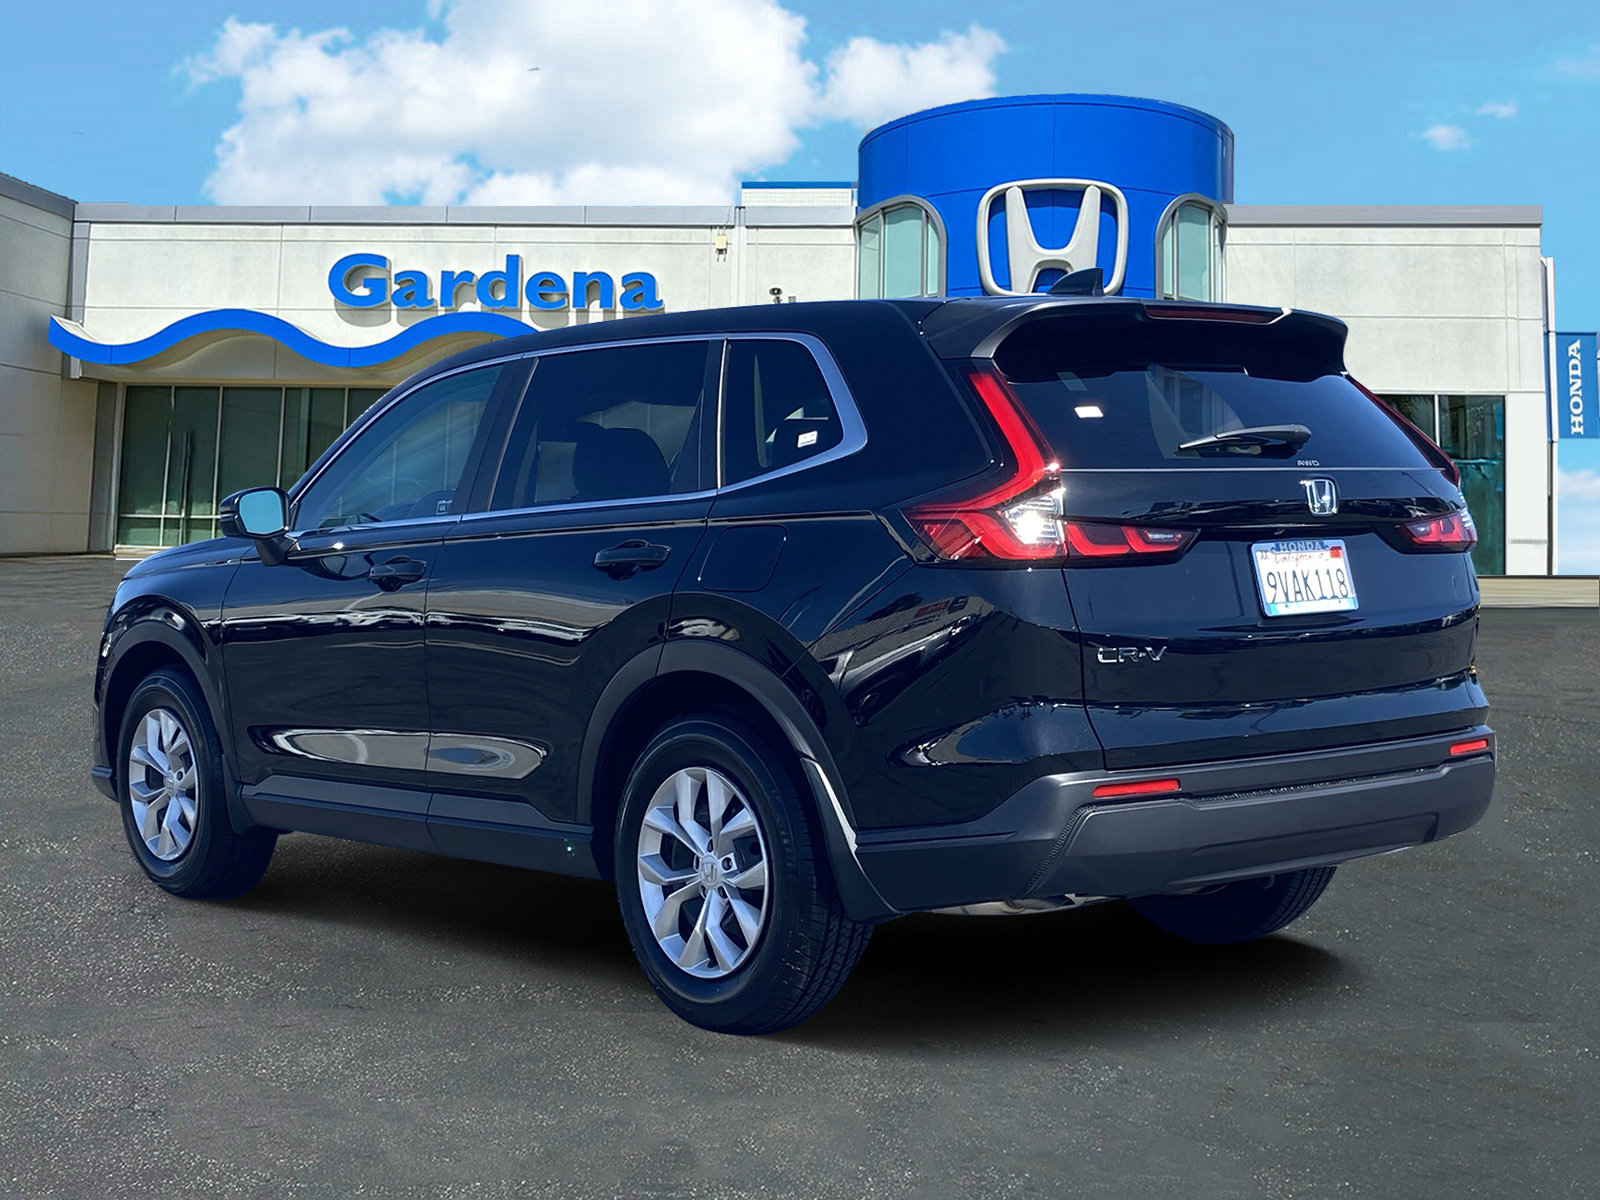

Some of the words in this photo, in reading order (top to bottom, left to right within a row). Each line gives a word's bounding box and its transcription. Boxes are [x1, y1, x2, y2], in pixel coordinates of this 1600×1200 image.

[328, 253, 664, 311] Gardena
[1568, 339, 1584, 435] HONDA
[1297, 459, 1320, 467] AWD
[1280, 541, 1321, 551] HONDA
[1266, 568, 1349, 603] 9VAK118
[1097, 646, 1167, 663] CR-V
